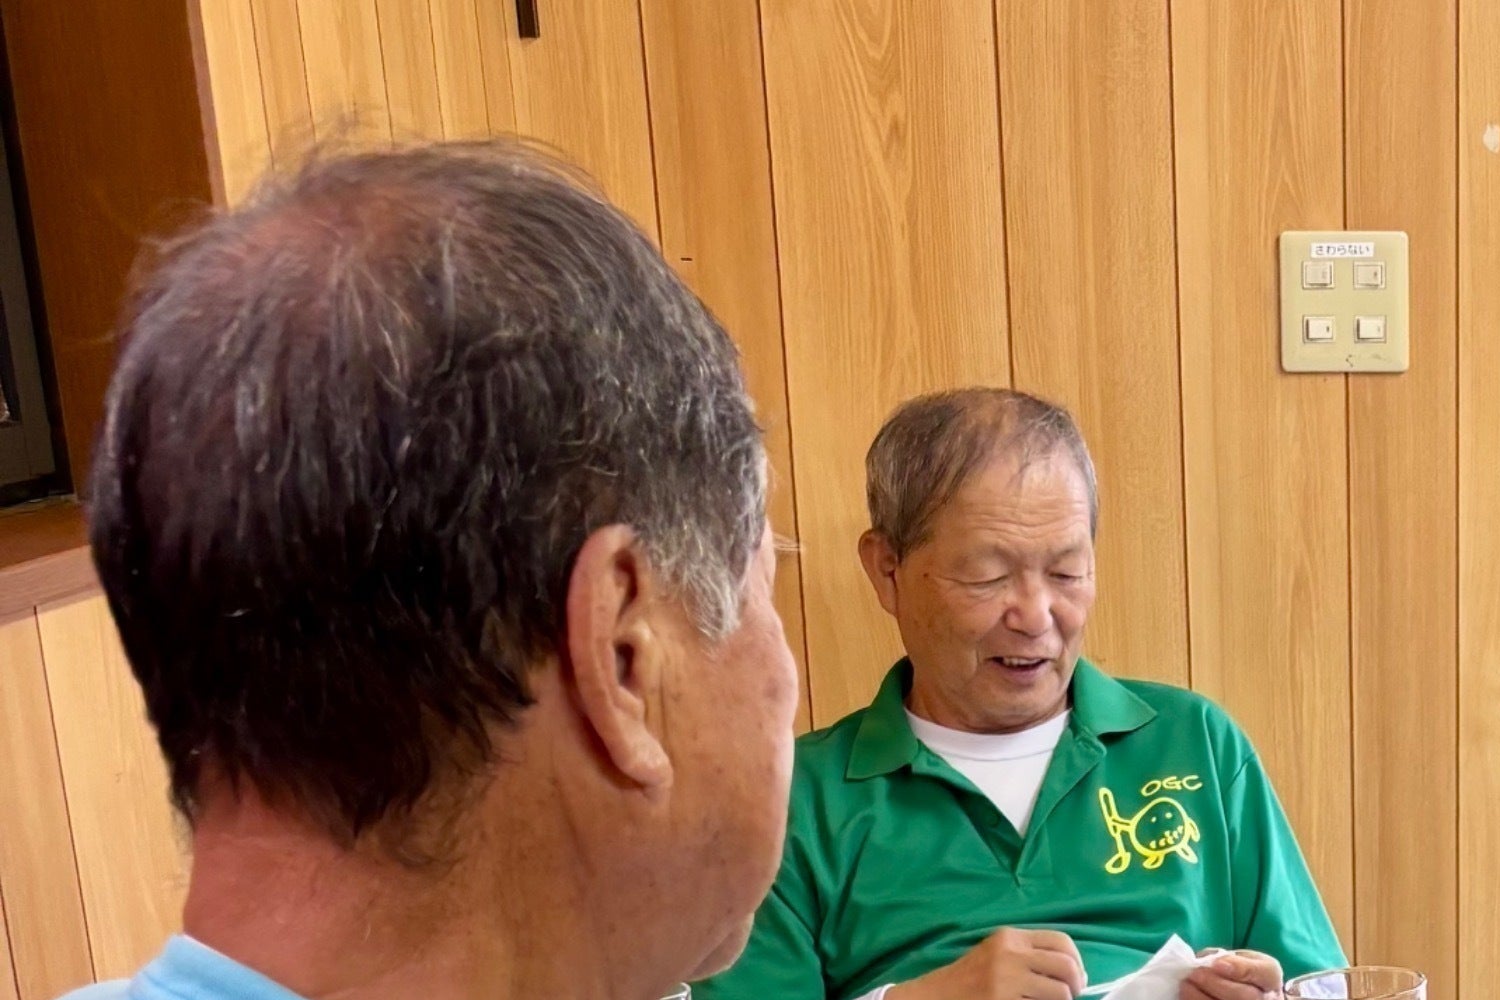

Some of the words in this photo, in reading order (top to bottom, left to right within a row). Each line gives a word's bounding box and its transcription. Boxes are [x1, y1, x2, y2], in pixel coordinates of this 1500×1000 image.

[1315, 244, 1370, 256] さわらない
[1141, 774, 1203, 797] OGC
